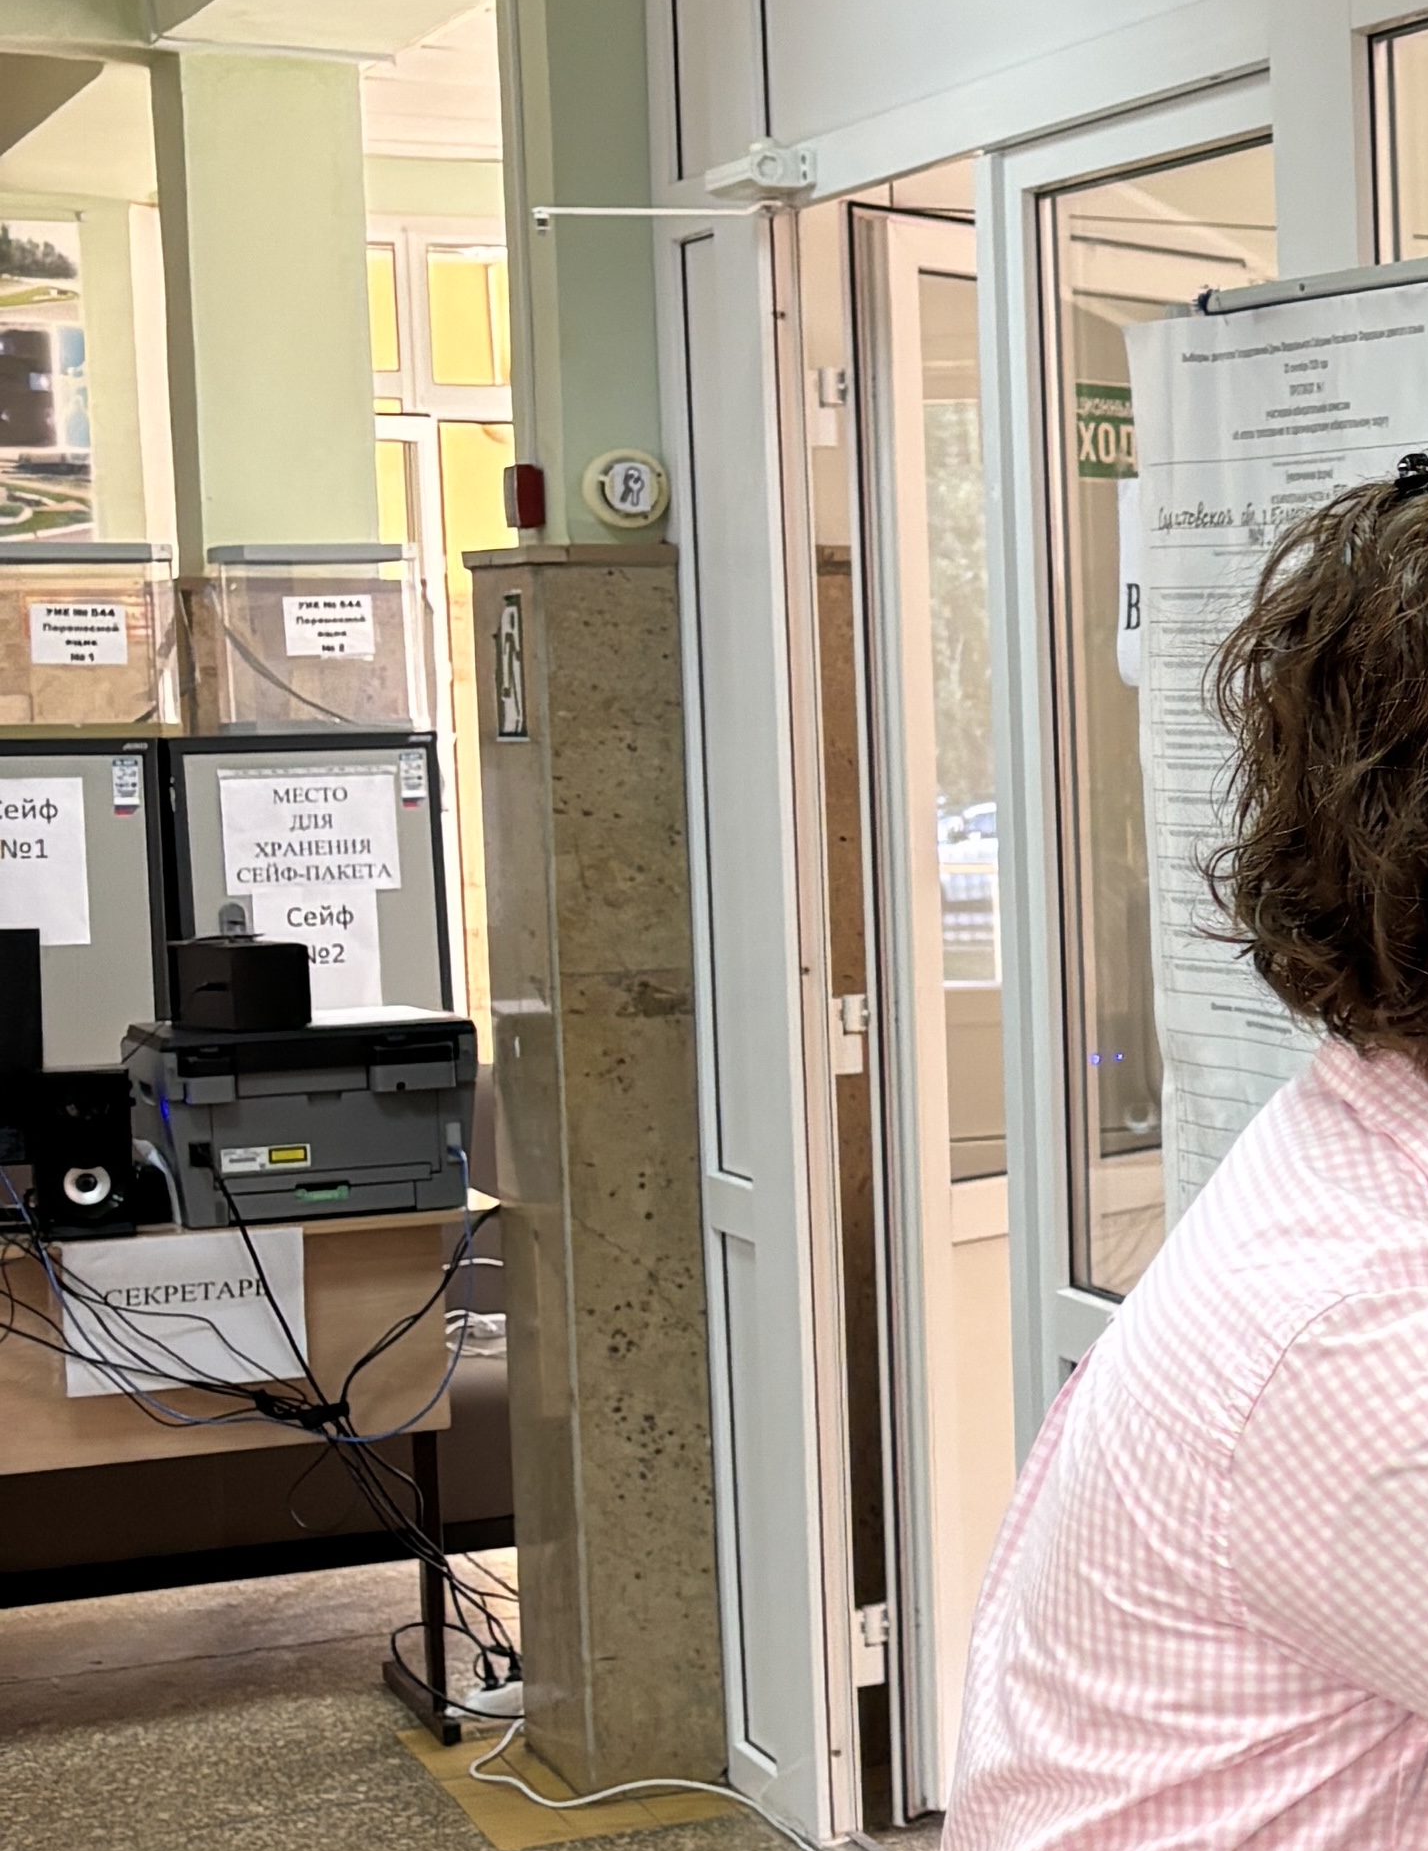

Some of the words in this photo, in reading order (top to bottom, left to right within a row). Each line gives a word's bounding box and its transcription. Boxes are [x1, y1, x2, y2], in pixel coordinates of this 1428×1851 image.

[1077, 420, 1138, 470] ХОД
[273, 786, 348, 805] МЕСТО
[0, 798, 58, 825] ейф
[289, 813, 333, 832] ДЛЯ
[0, 838, 49, 859] №1
[254, 837, 371, 858] ХРАНЕНИЯ
[236, 862, 393, 884] СЕЙФ-ПАКЕТА
[286, 904, 354, 930] Сейф
